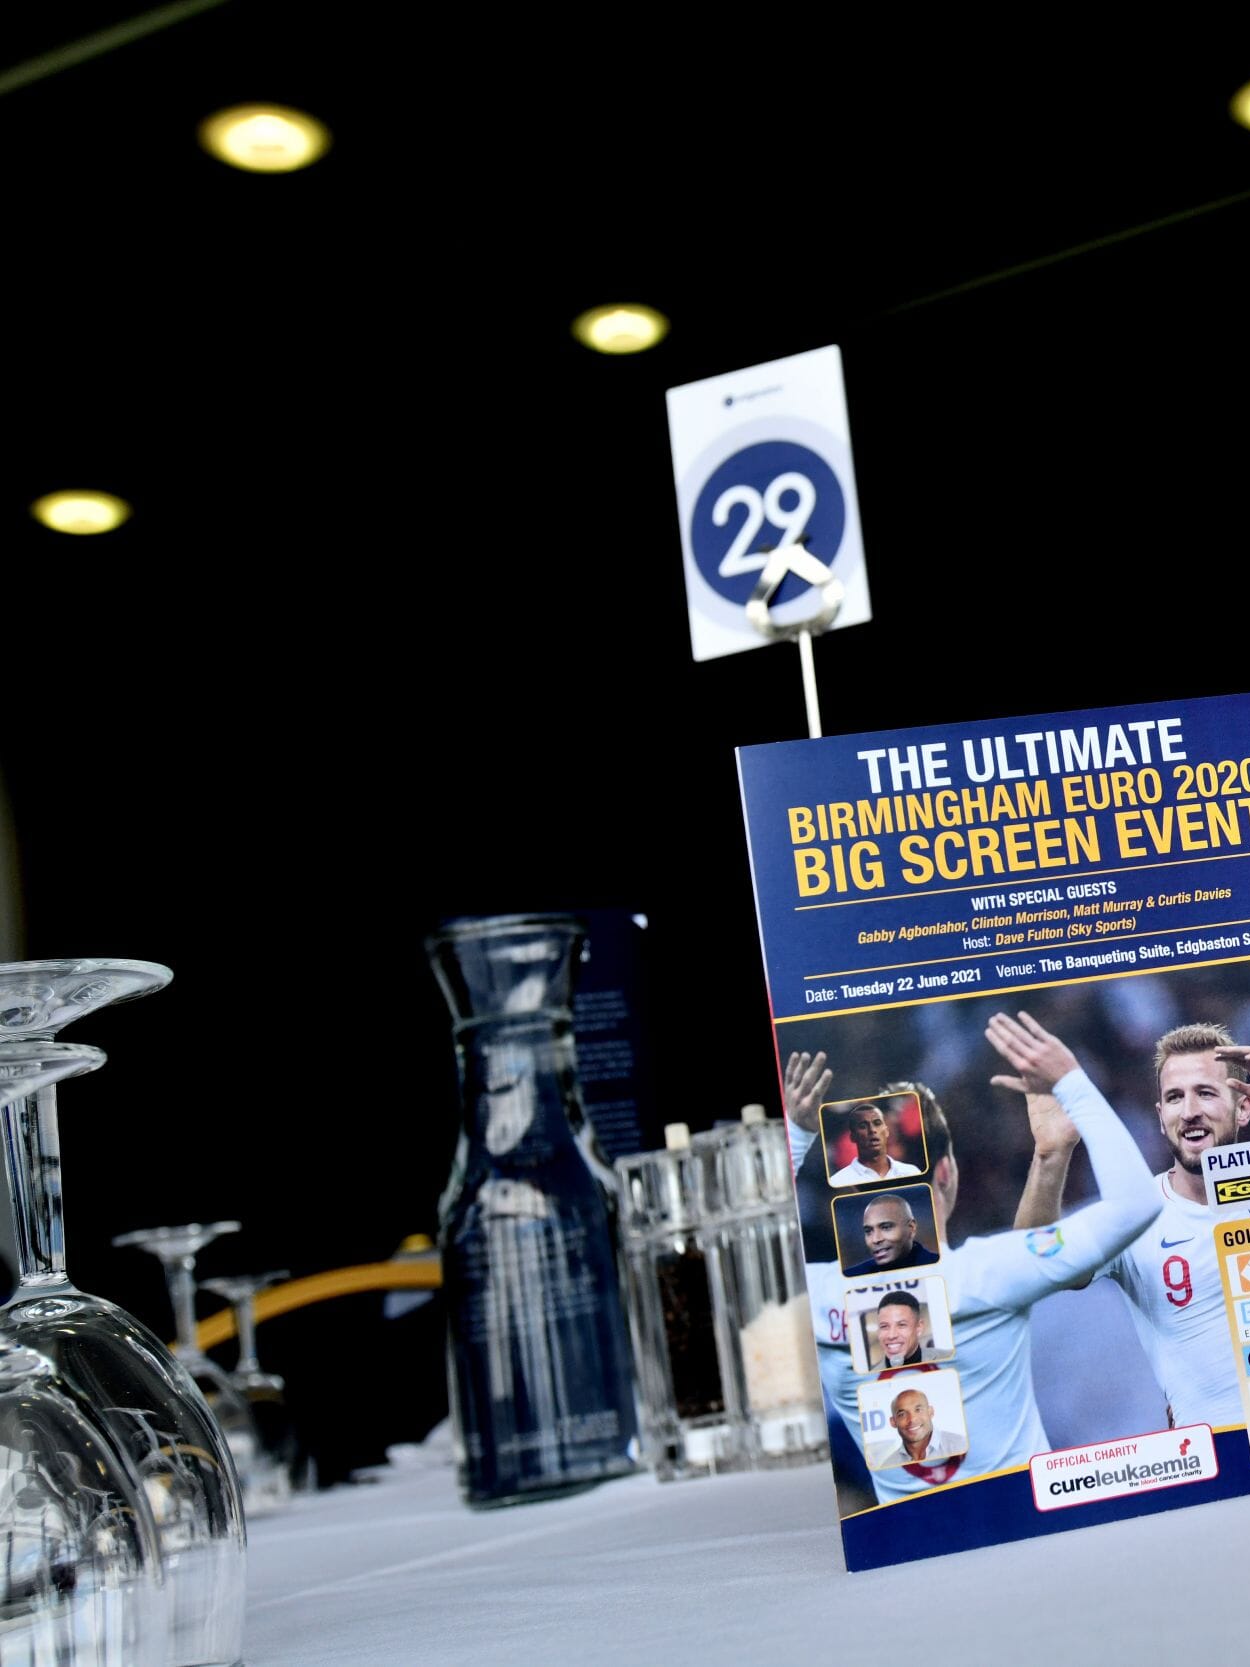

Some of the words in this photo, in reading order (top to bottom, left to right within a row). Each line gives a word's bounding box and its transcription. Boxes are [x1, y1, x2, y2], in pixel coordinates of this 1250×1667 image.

[712, 472, 817, 578] 29
[857, 742, 952, 793] THE
[962, 718, 1187, 783] ULTIMATE
[787, 780, 1051, 845] BIRMINGHAM
[1062, 768, 1162, 813] EURO
[793, 841, 885, 897] BIG
[900, 815, 1101, 885] SCREEN
[858, 930, 896, 945] Gabby
[898, 921, 969, 941] Agbonlahor,
[971, 915, 1012, 930] Clinton
[1015, 907, 1071, 925] Morrison,
[1073, 903, 1100, 917] Matt
[1103, 898, 1143, 914] Murray
[1146, 896, 1155, 908] &
[1158, 891, 1191, 907] Curtis
[1194, 887, 1232, 902] Davies
[971, 897, 1006, 911] WITH
[1009, 887, 1064, 906] SPECIAL
[1066, 881, 1117, 900] GUESTS
[962, 936, 991, 950] Host:
[995, 932, 1024, 946] Dave
[1027, 926, 1063, 942] Fulton
[1067, 922, 1092, 939] (Sky
[1095, 917, 1136, 935] Sports)
[805, 988, 838, 1004] Date:
[840, 979, 894, 999] Tuesday
[897, 977, 914, 991] 22
[916, 974, 948, 989] June
[951, 968, 982, 984] 2021
[996, 963, 1036, 978] Venue:
[1039, 959, 1062, 973] The
[1066, 947, 1136, 970] Banqueting
[1139, 942, 1175, 959] Suite,
[1177, 935, 1240, 956] Edgbaston
[1163, 1255, 1193, 1307] 9
[1046, 1453, 1092, 1471] OFFICIAL
[1094, 1443, 1138, 1461] CHARITY
[1049, 1455, 1201, 1496] cureleukaemia
[1140, 1477, 1158, 1486] blood
[1159, 1473, 1180, 1482] cancer
[1181, 1468, 1203, 1478] charity
